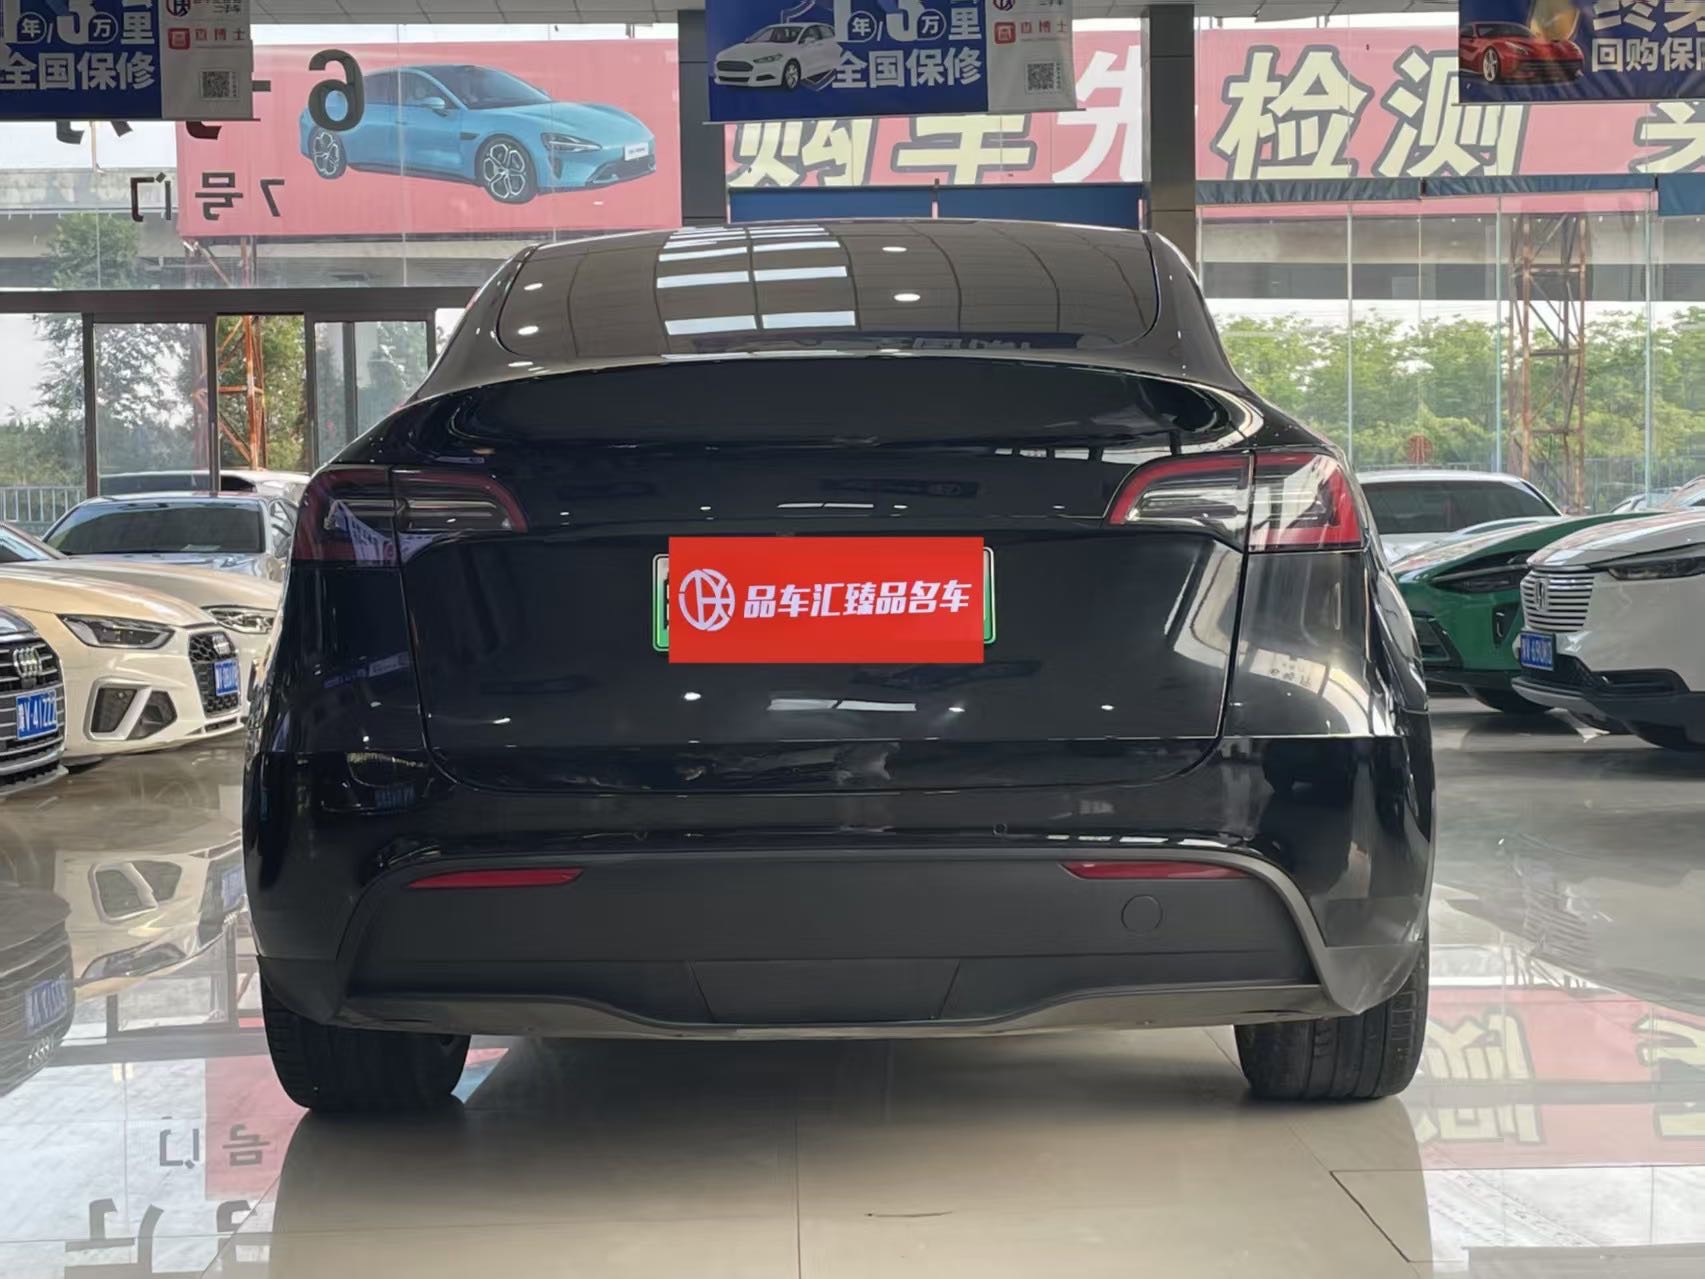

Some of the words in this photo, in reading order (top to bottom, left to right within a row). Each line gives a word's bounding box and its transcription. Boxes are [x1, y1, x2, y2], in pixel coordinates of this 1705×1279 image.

[0, 51, 155, 90] 全国保修
[832, 46, 982, 89] 全国保修
[1592, 37, 1705, 72] 回购保
